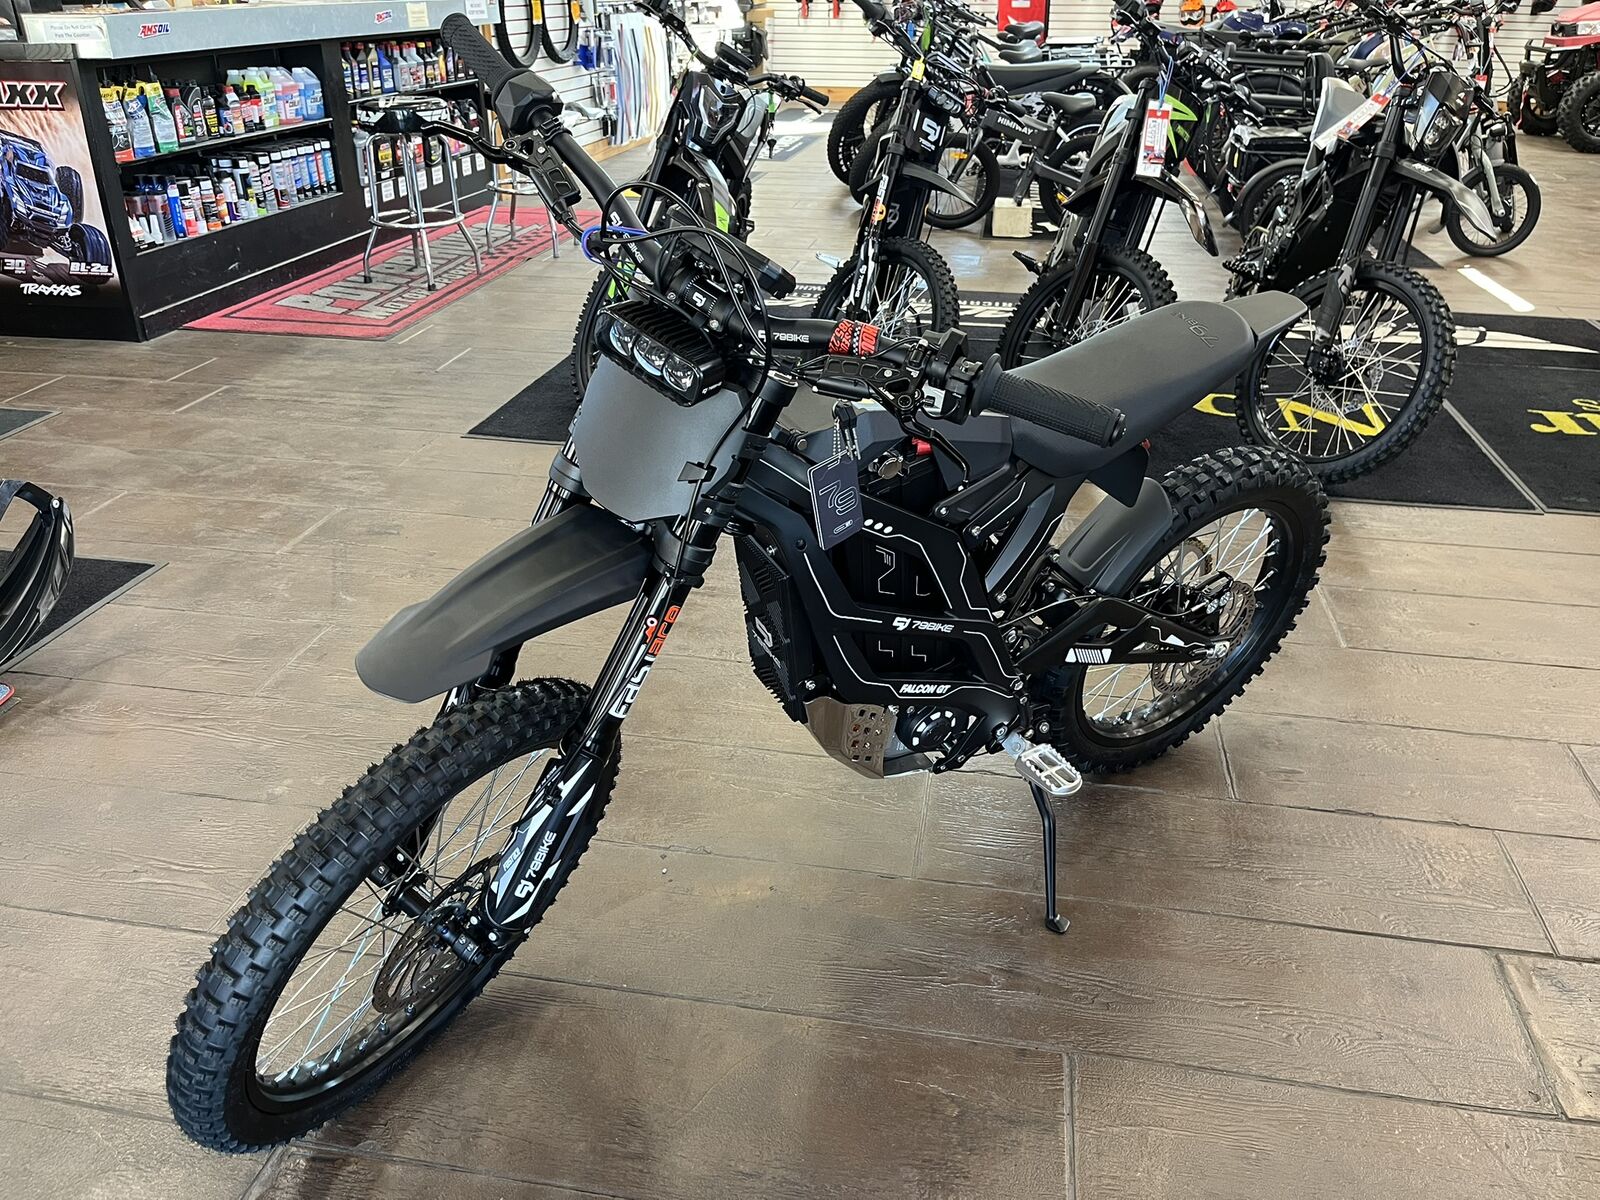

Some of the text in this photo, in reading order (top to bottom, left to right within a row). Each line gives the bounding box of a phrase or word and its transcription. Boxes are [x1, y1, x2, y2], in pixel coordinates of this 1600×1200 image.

[139, 23, 170, 38] AMSOIL
[997, 116, 1033, 136] HIMIWAY
[20, 283, 82, 297] TRAXXAS
[772, 332, 810, 344] 79BIKE
[911, 620, 955, 633] 79BIKE
[900, 684, 951, 694] FALCON GT
[525, 830, 557, 882] 79BIKE
